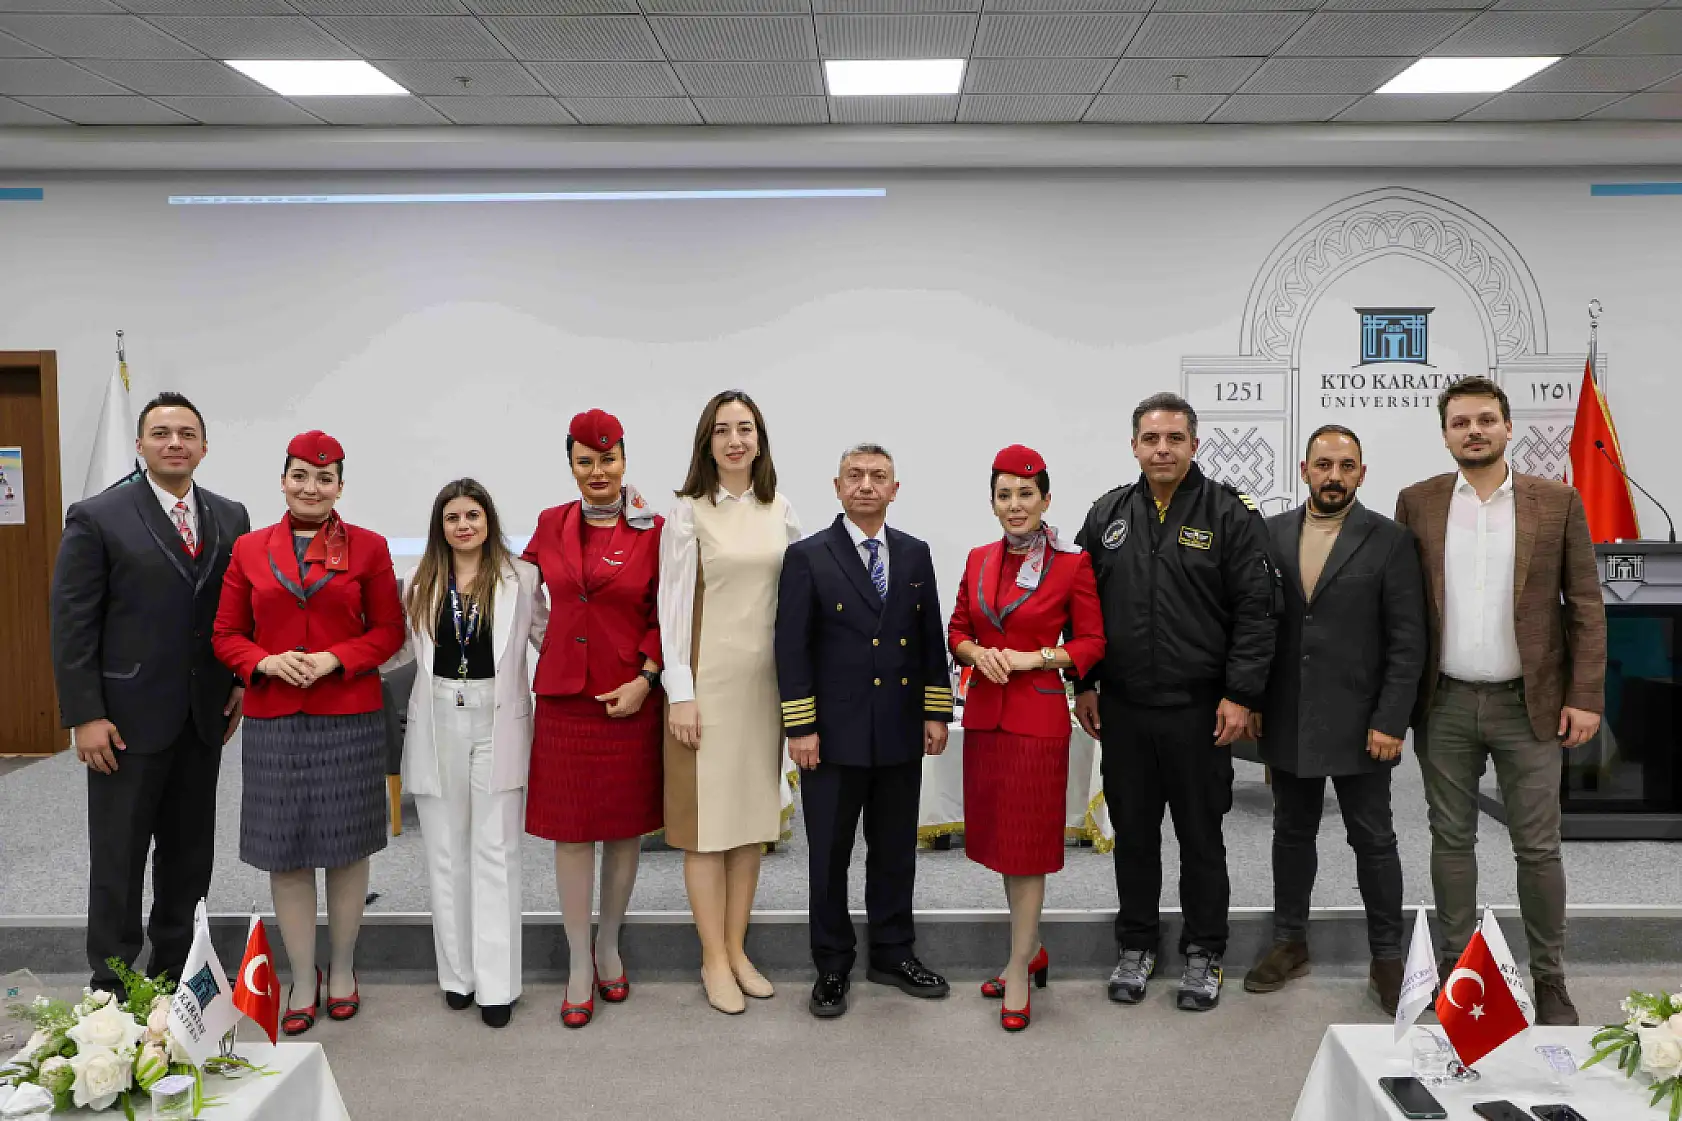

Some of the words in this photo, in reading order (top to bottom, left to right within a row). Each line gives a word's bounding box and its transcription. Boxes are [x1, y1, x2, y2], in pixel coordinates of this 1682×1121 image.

[1320, 373, 1366, 390] KTO
[1214, 382, 1263, 401] 1251
[1320, 393, 1440, 408] ÜNİVERSİT
